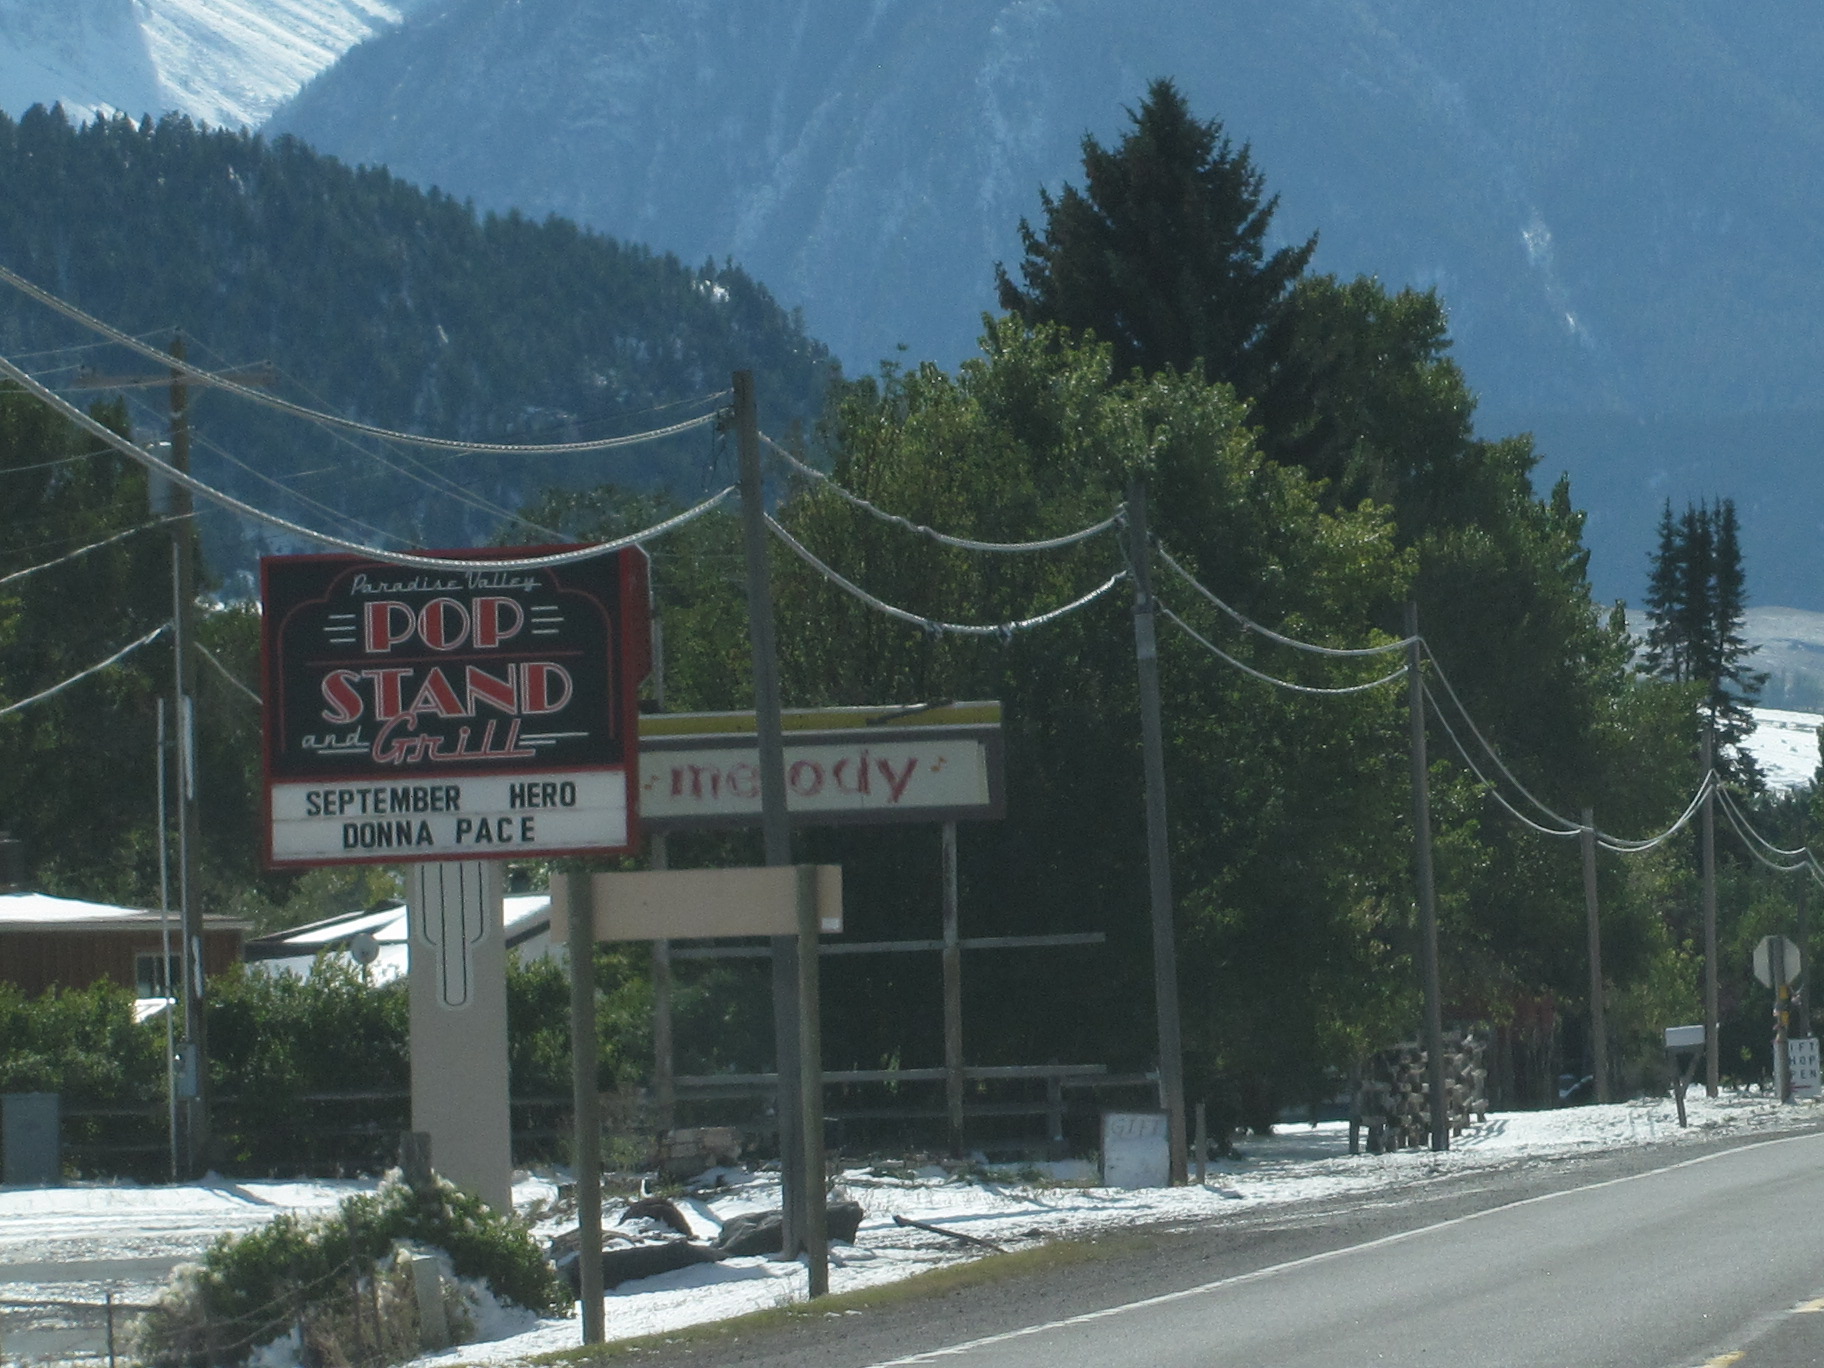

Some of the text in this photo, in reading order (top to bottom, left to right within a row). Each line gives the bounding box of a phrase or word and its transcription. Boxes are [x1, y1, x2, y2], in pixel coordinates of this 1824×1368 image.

[351, 571, 542, 595] Paradise Valley
[364, 597, 524, 653] POP
[321, 662, 573, 724] STAND
[301, 712, 536, 765] and Grill
[306, 781, 577, 816] SEPTEMBER HERO
[670, 748, 919, 804] meody
[342, 816, 536, 850] DONNA PACE
